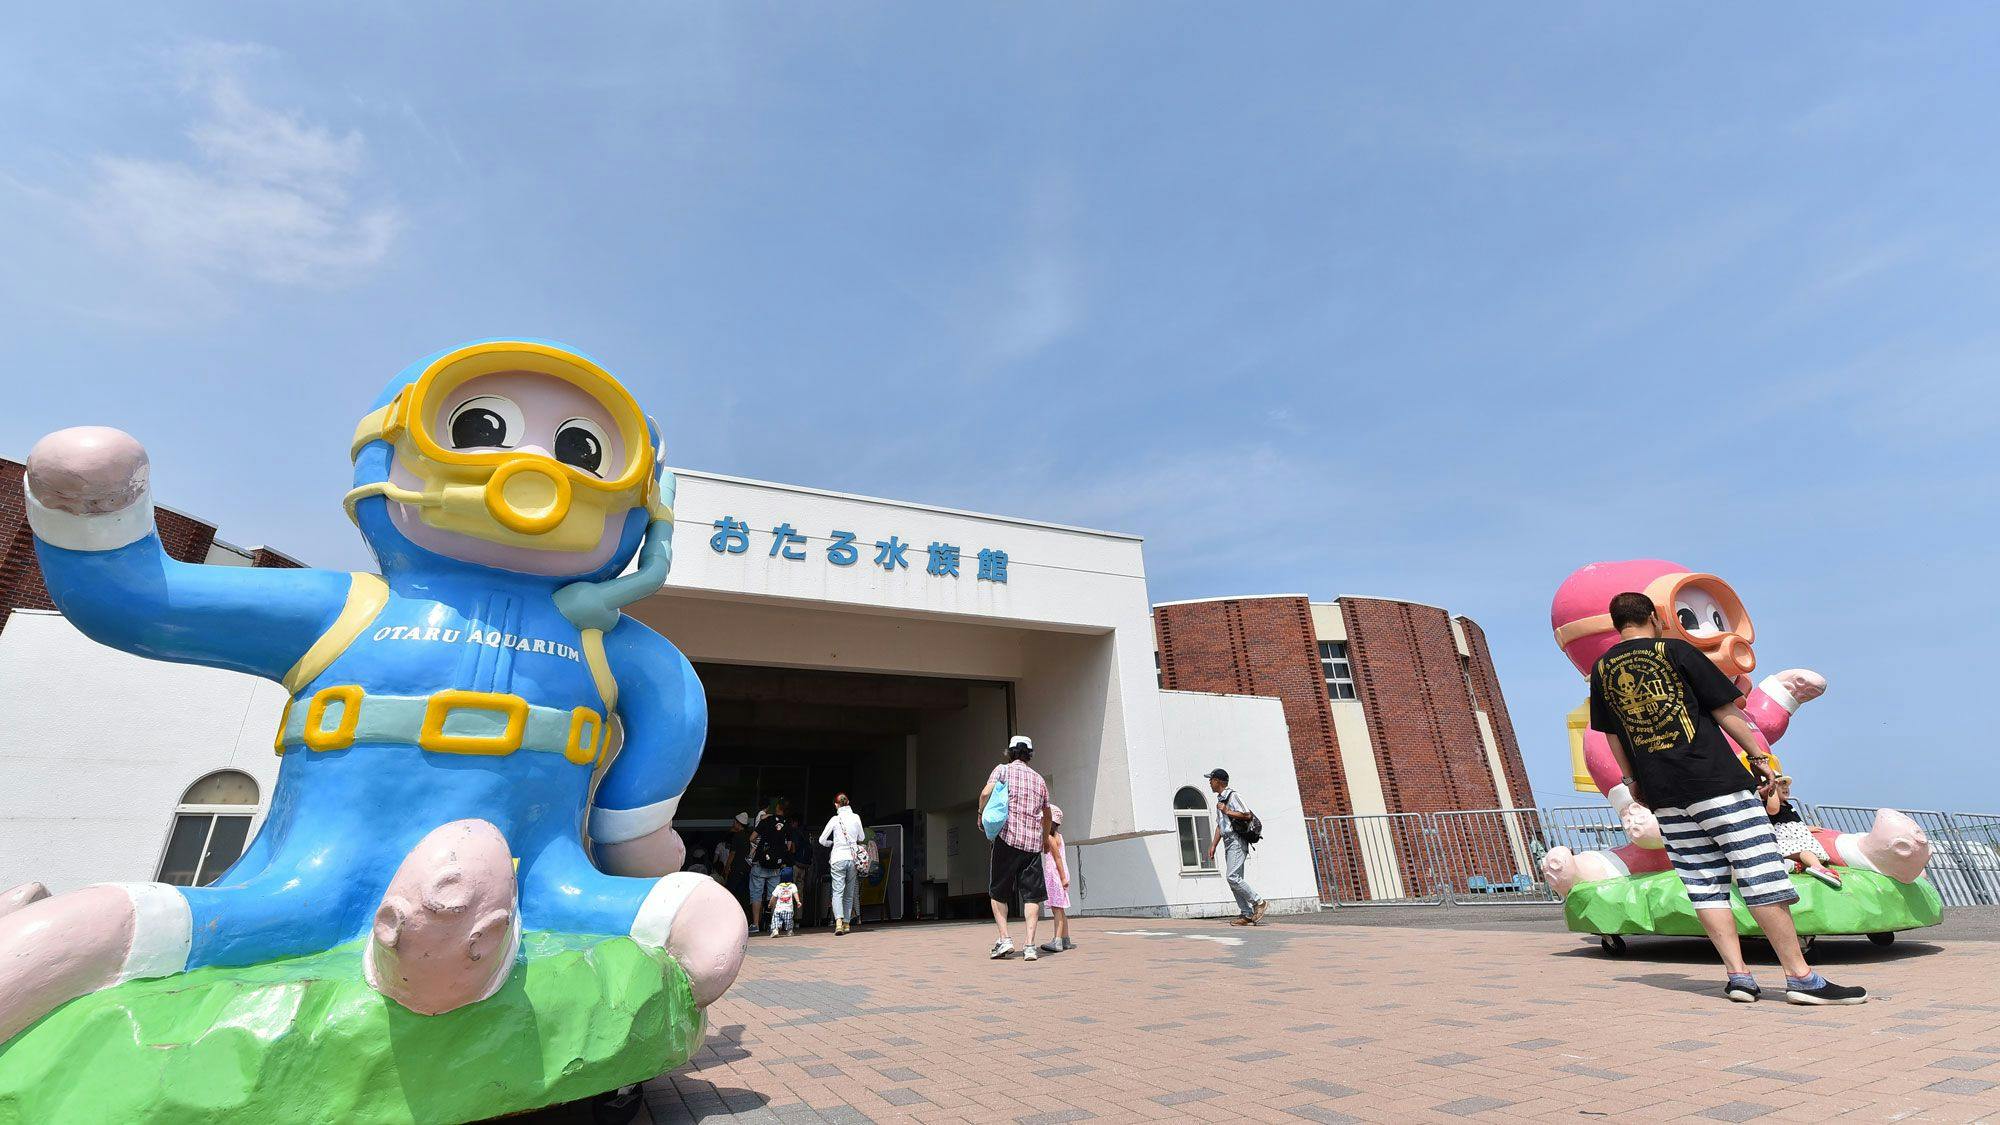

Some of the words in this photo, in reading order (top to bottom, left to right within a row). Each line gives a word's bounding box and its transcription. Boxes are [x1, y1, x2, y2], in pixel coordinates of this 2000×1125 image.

[710, 516, 1009, 584] おたる水族館
[373, 625, 461, 643] OTARU
[466, 630, 581, 663] AQUARIUM
